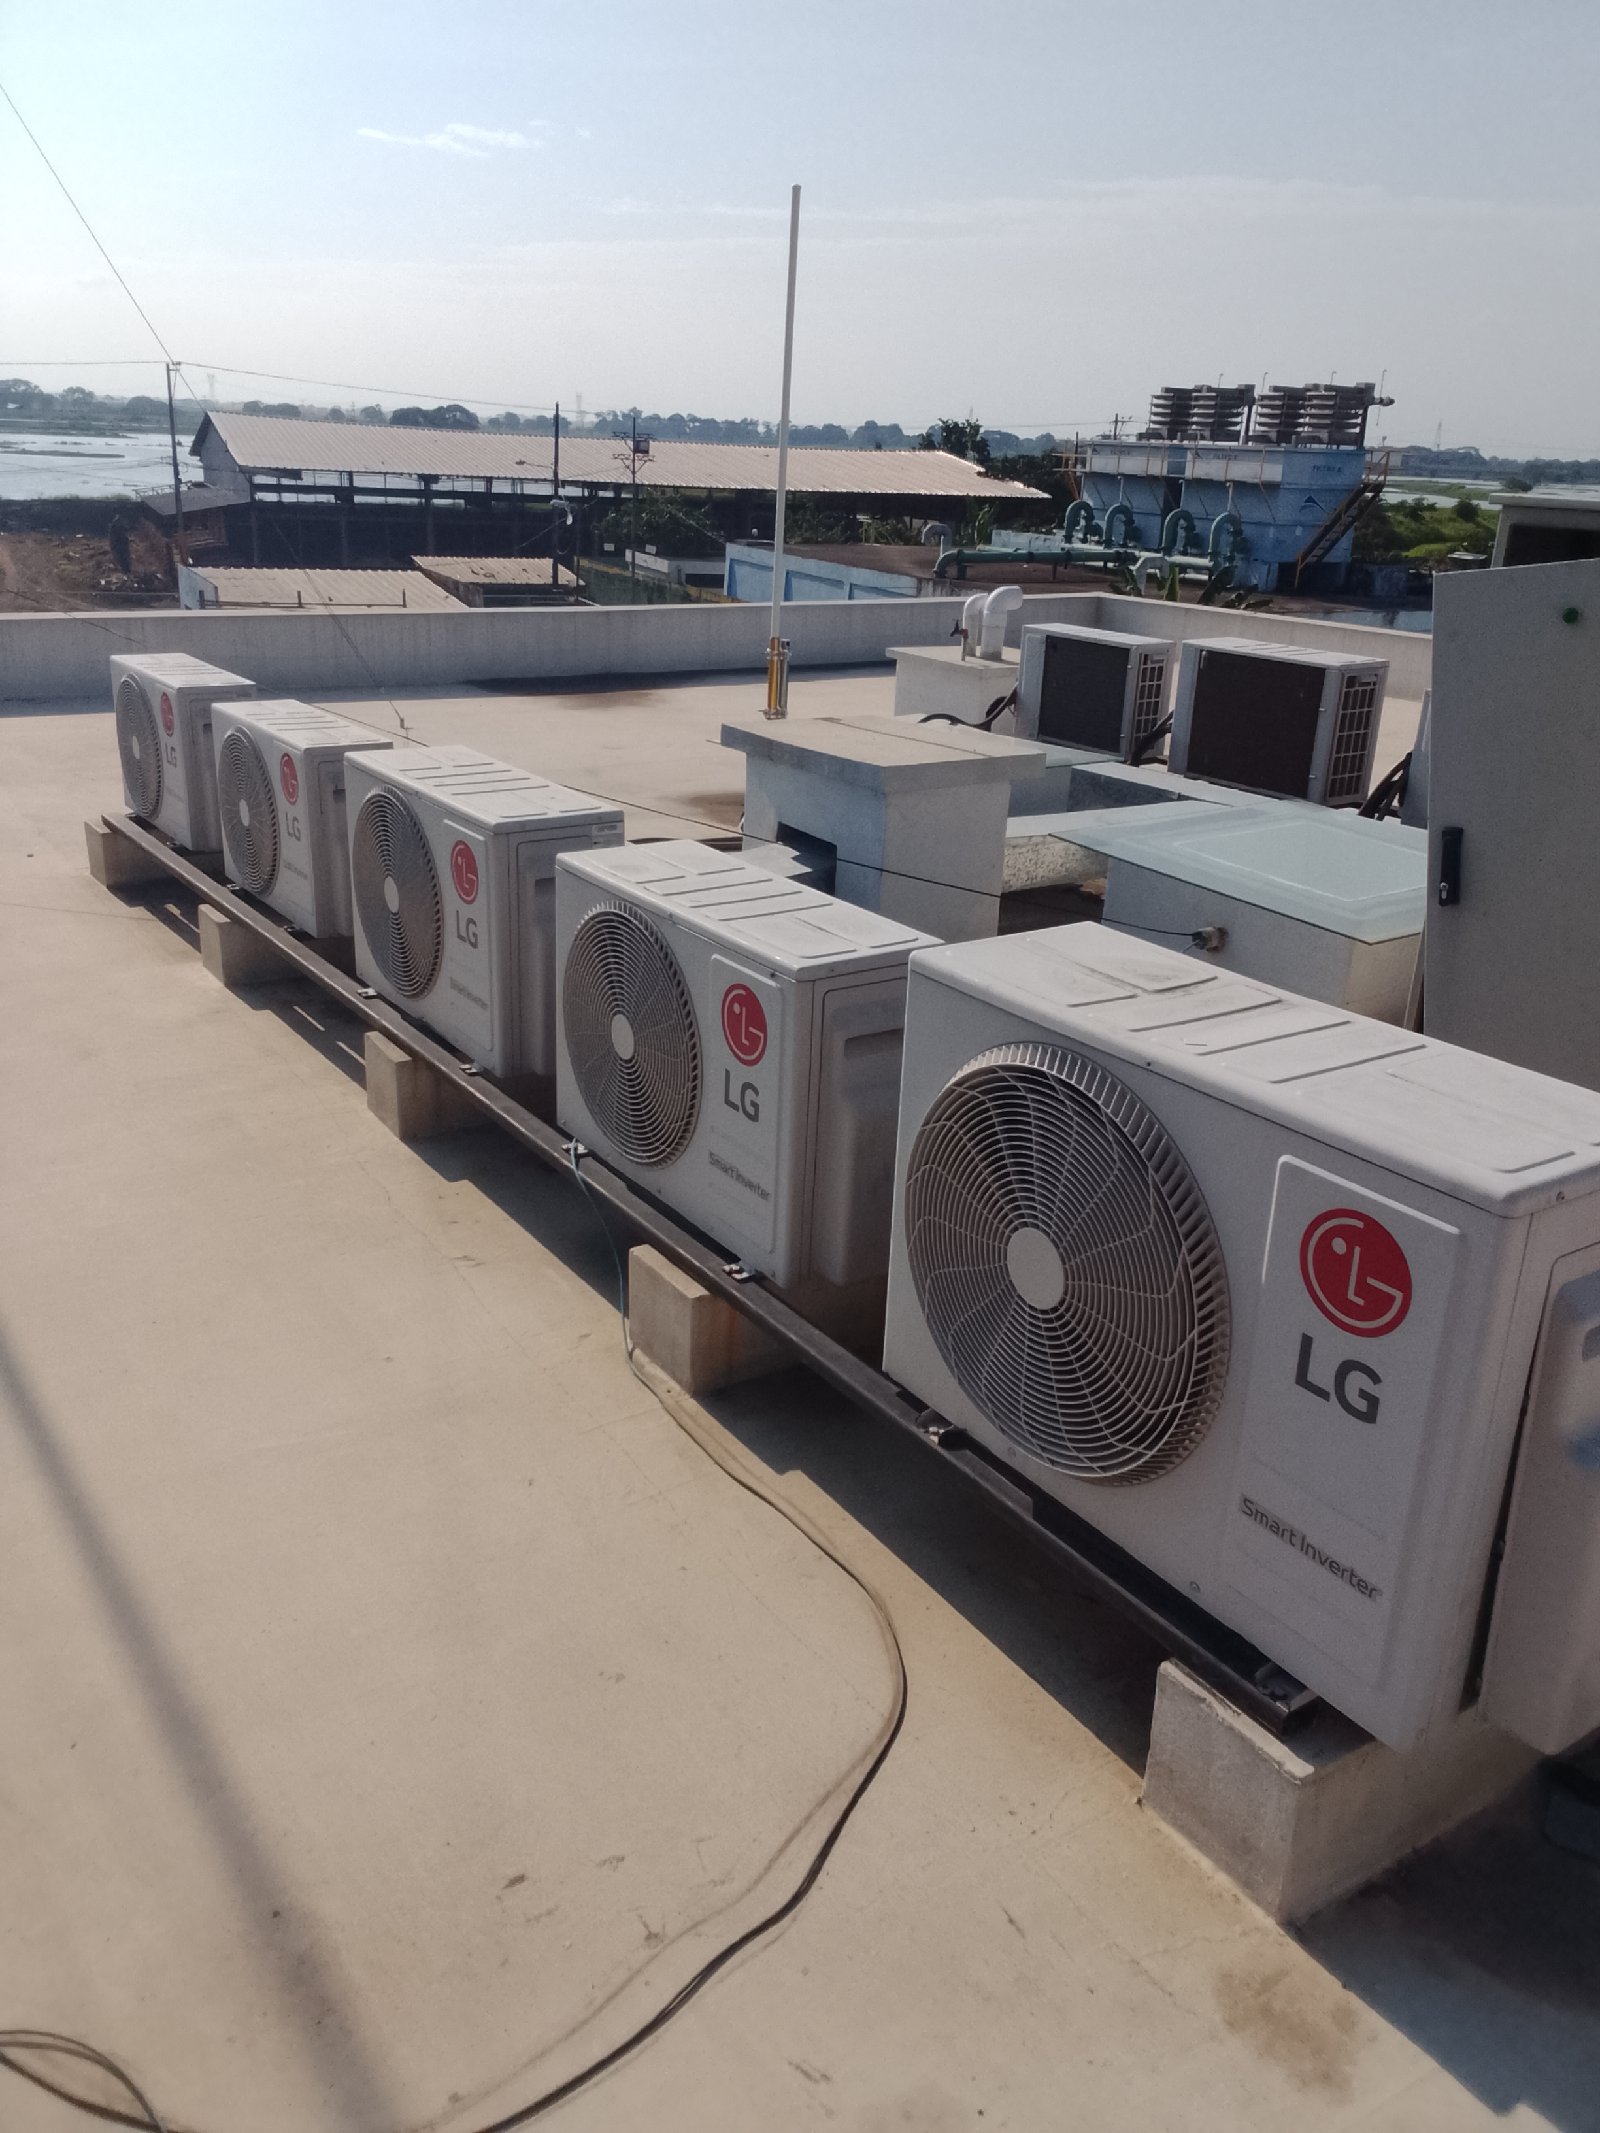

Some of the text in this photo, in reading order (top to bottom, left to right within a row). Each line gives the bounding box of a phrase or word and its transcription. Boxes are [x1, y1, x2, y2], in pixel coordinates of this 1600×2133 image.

[165, 742, 177, 769] LG
[285, 811, 302, 842] LG
[456, 910, 478, 949] LG
[723, 1068, 760, 1123] LG
[1294, 1333, 1384, 1425] LG
[1241, 1496, 1378, 1599] Smart Inverter
